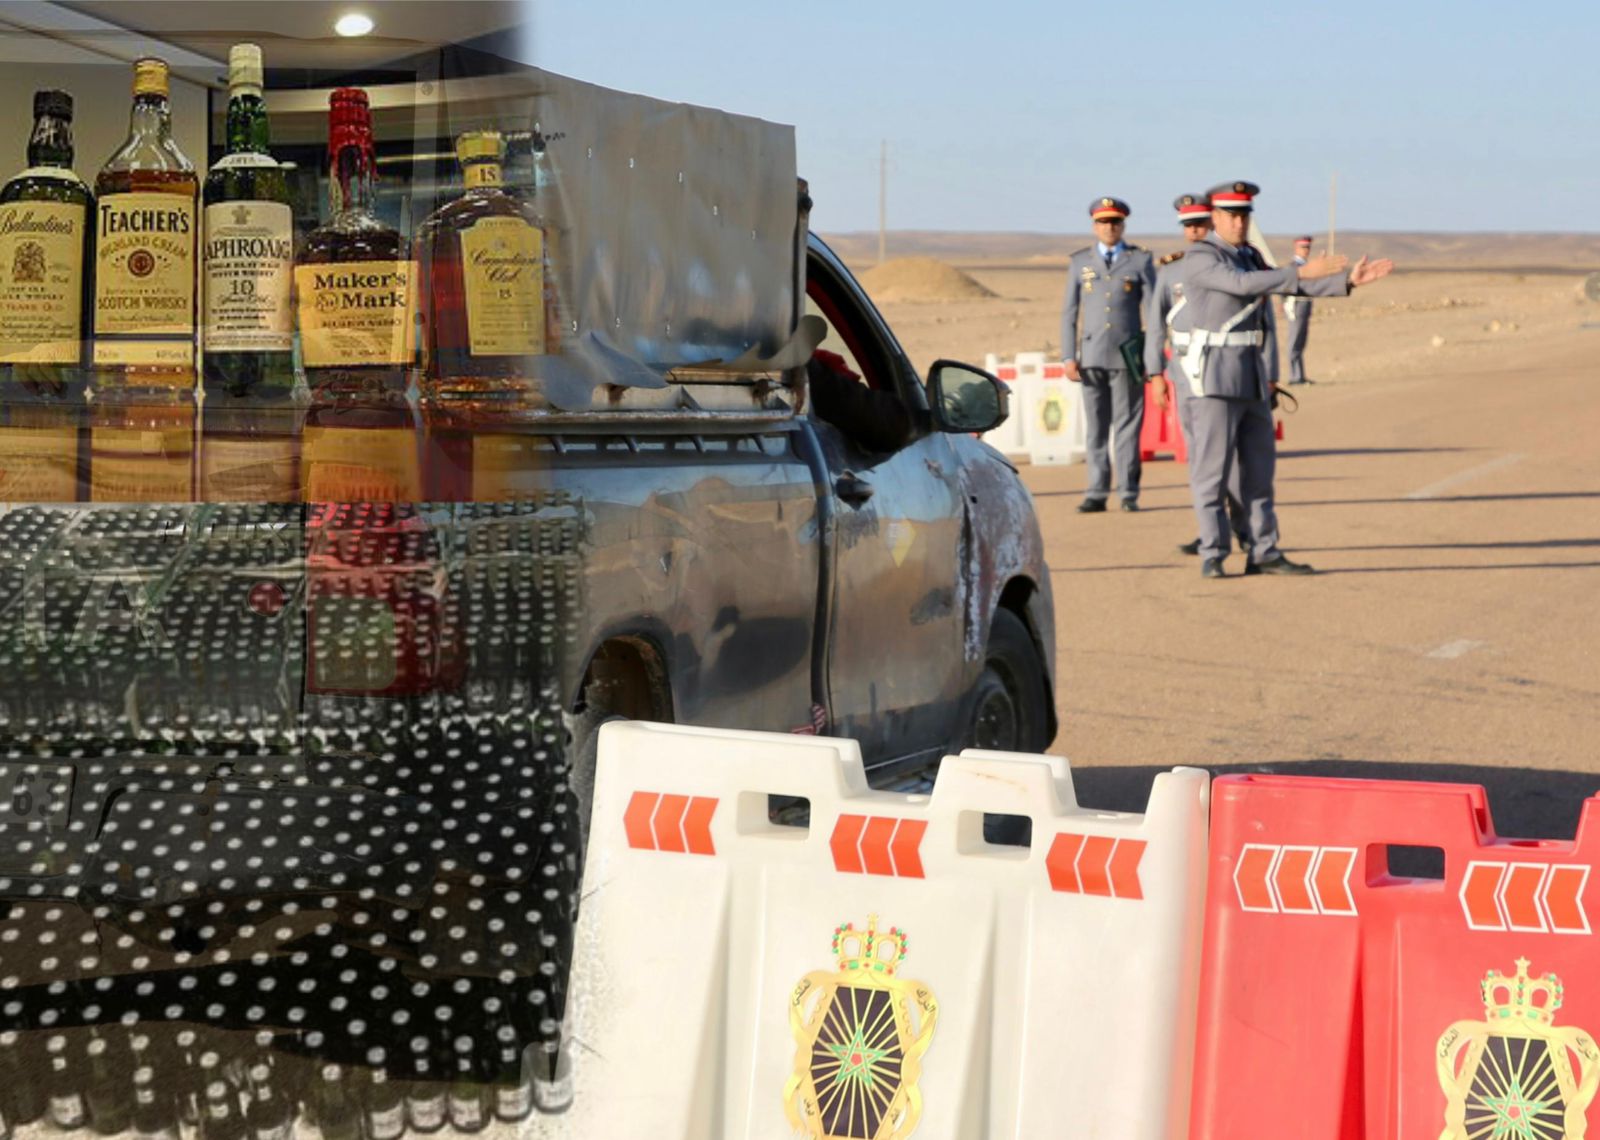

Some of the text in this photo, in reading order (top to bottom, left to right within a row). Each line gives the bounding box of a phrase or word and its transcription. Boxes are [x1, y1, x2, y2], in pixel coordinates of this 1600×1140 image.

[101, 204, 190, 237] TEACHER'S
[229, 279, 255, 296] 10
[313, 271, 406, 290] Maker's
[340, 291, 406, 310] Mark
